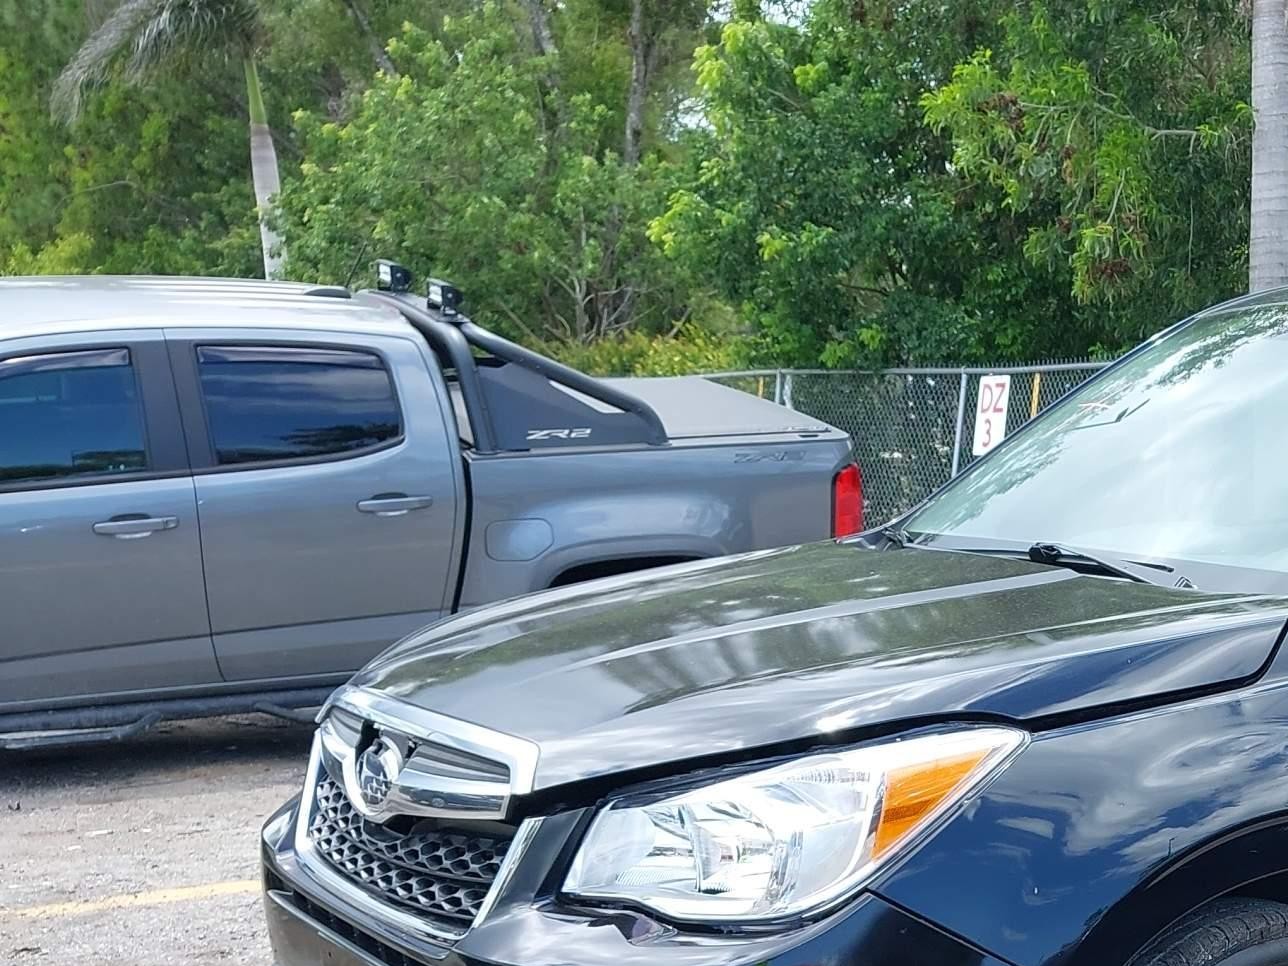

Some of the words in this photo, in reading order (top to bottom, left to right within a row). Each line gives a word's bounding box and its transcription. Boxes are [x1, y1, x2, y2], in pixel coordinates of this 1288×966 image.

[981, 382, 1006, 413] DZ
[526, 428, 592, 440] ZR2
[982, 418, 992, 448] 3
